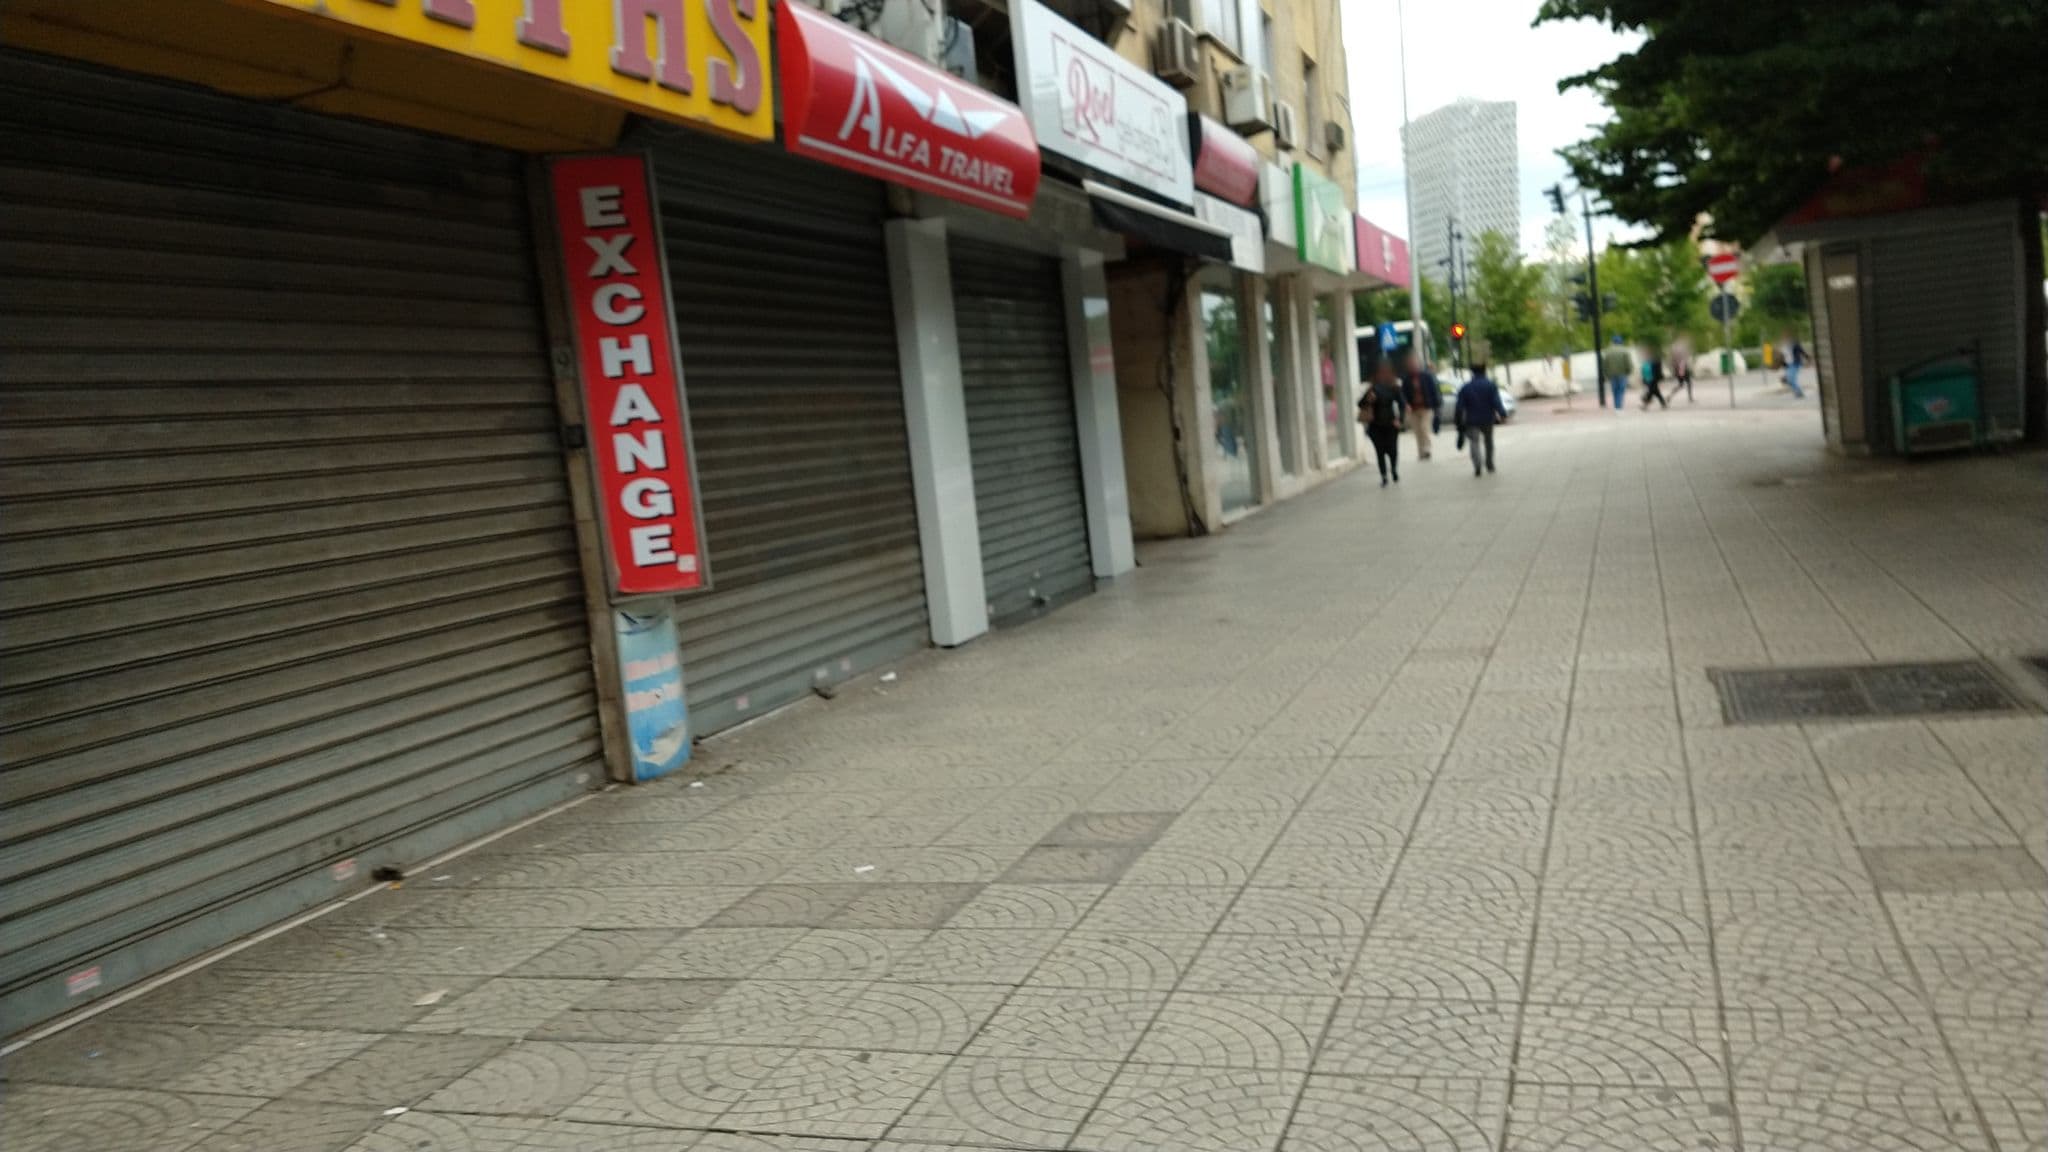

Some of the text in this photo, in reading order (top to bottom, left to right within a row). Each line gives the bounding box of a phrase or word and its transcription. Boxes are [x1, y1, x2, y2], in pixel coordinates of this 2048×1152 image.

[838, 56, 1015, 195] ALFA TRAVEL
[579, 185, 677, 568] EXCHANGE
